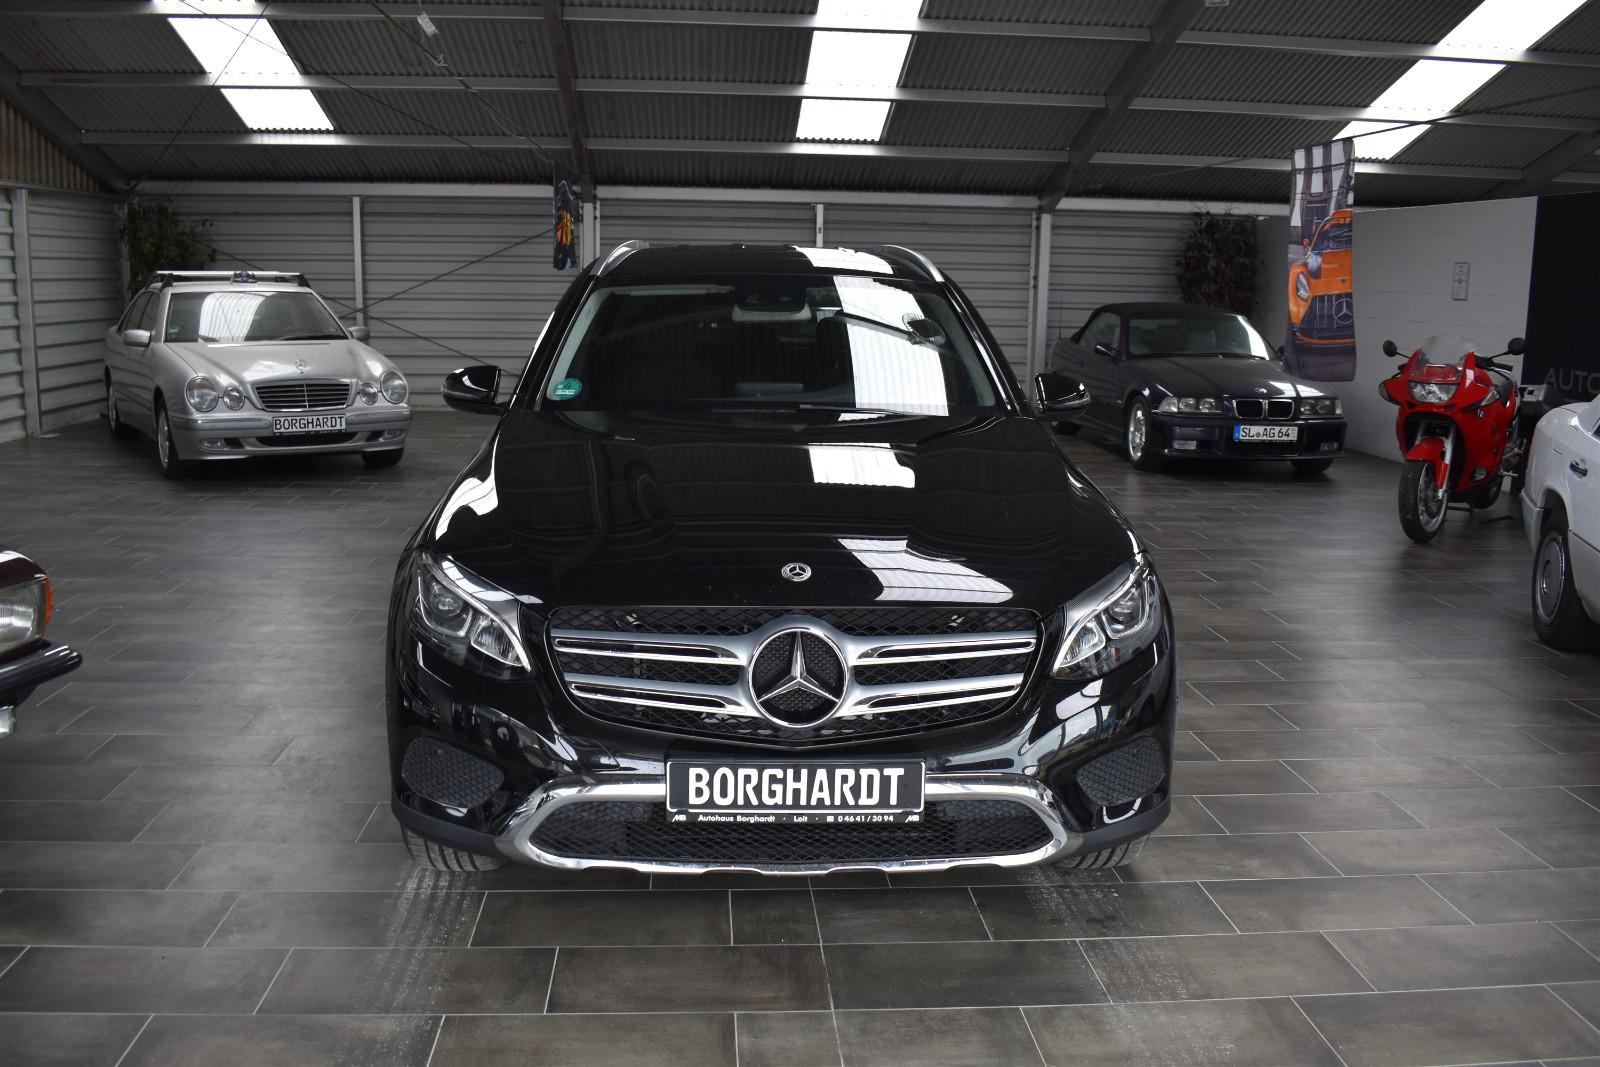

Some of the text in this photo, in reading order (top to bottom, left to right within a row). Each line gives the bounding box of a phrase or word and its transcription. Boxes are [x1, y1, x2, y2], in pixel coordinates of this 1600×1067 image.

[274, 417, 344, 430] BORGHARDT
[1241, 427, 1254, 438] SL
[1262, 427, 1276, 439] AG
[1277, 427, 1290, 439] 64
[688, 767, 905, 806] BORGHARDT
[698, 814, 734, 822] Autohaus
[736, 814, 776, 824] Borghardt
[793, 815, 808, 823] Loit
